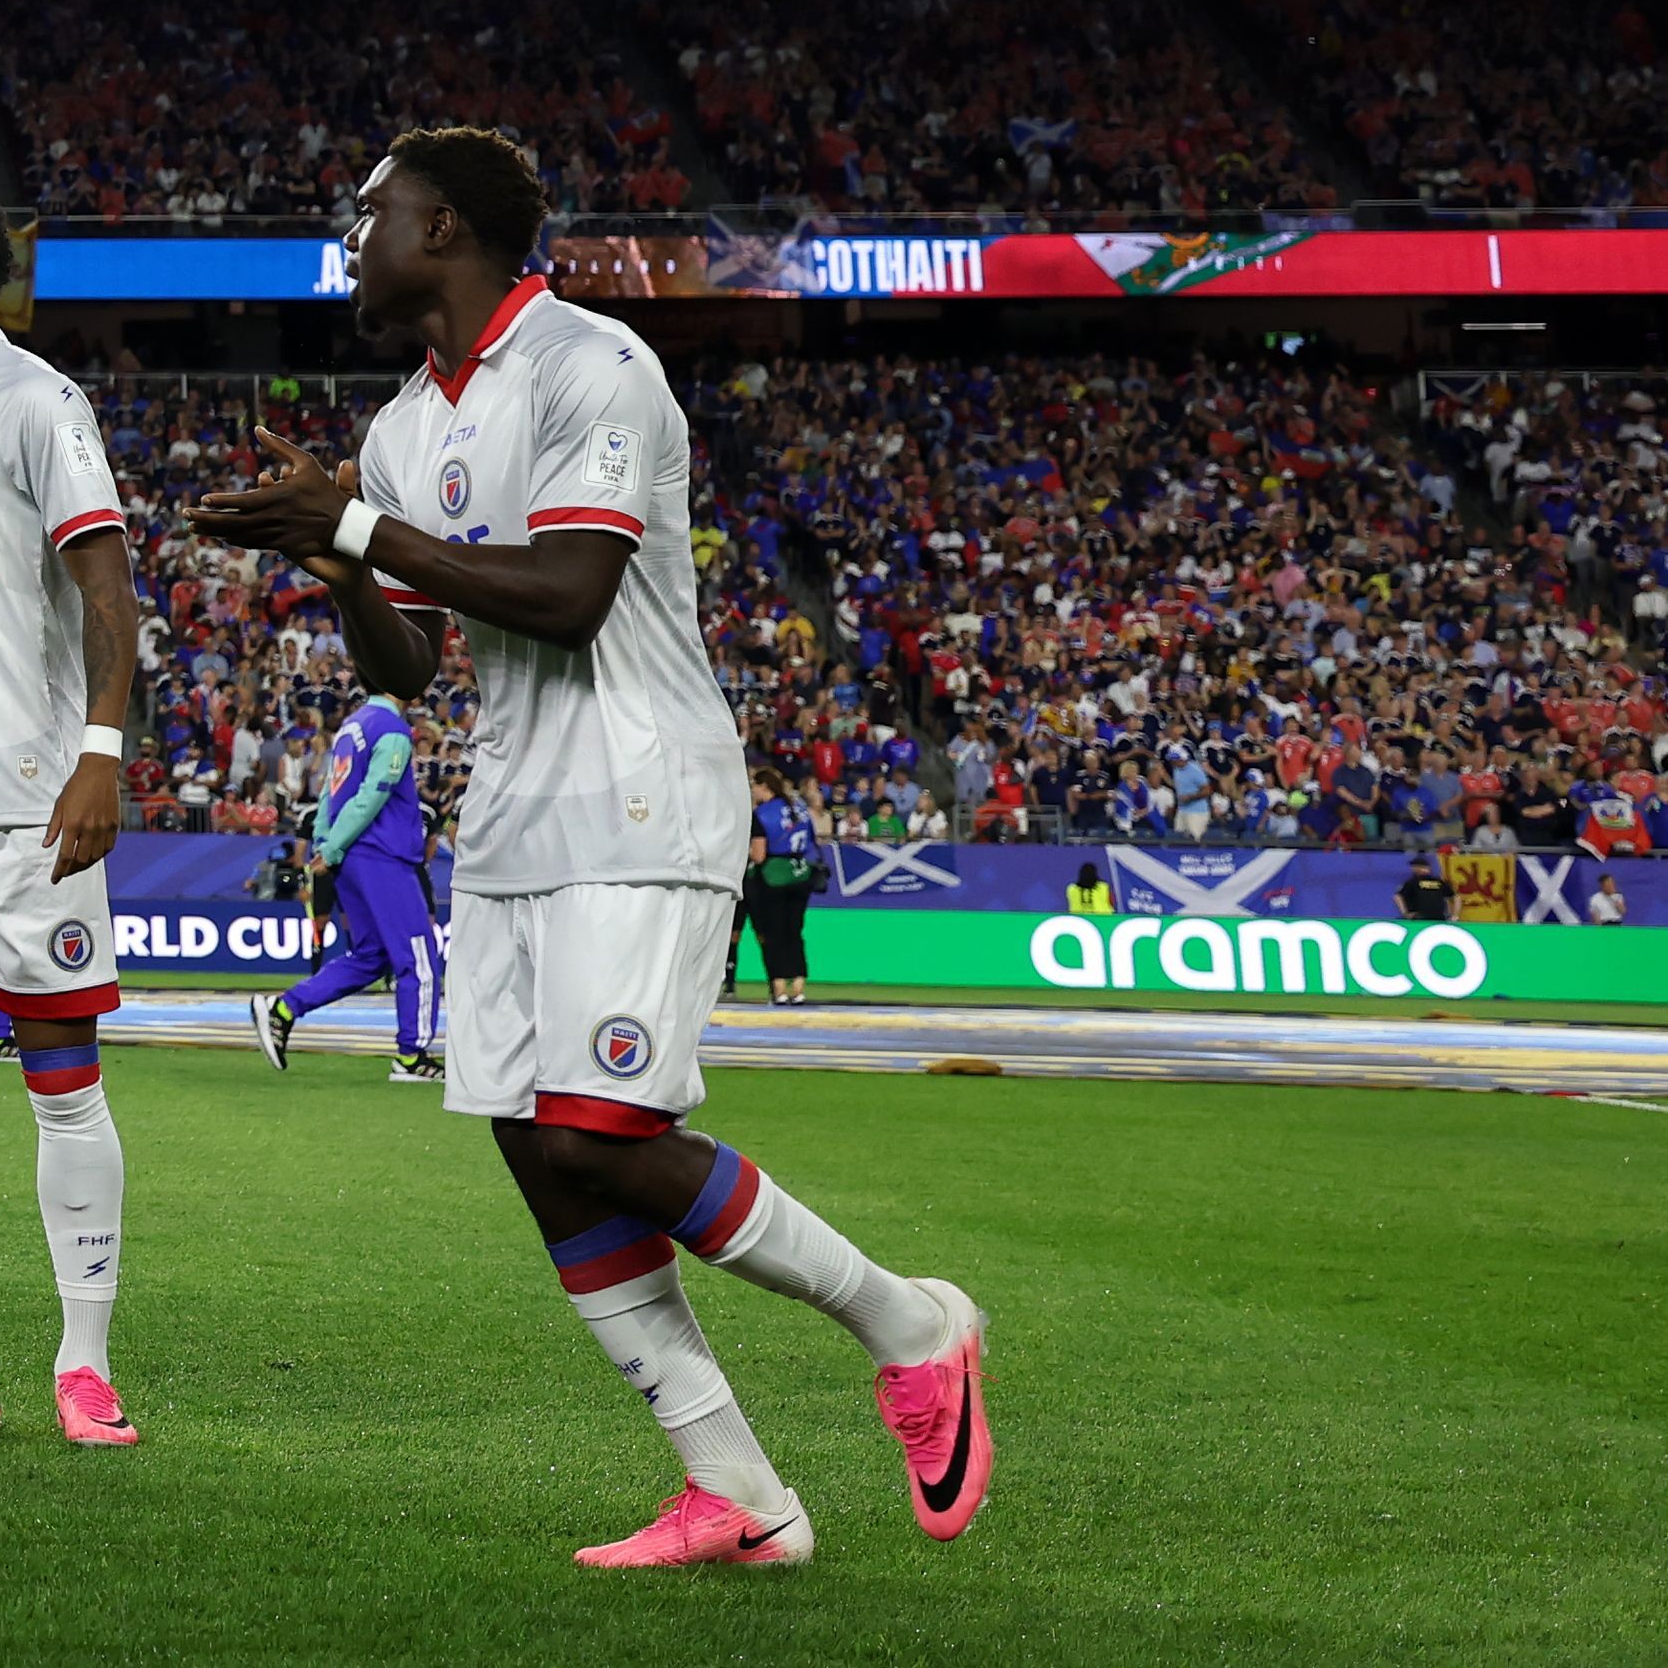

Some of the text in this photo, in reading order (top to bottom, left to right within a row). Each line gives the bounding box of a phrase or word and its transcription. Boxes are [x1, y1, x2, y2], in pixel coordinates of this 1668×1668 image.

[599, 462, 626, 477] PEACE
[1030, 914, 1487, 998] aramco
[78, 1233, 115, 1248] FHF
